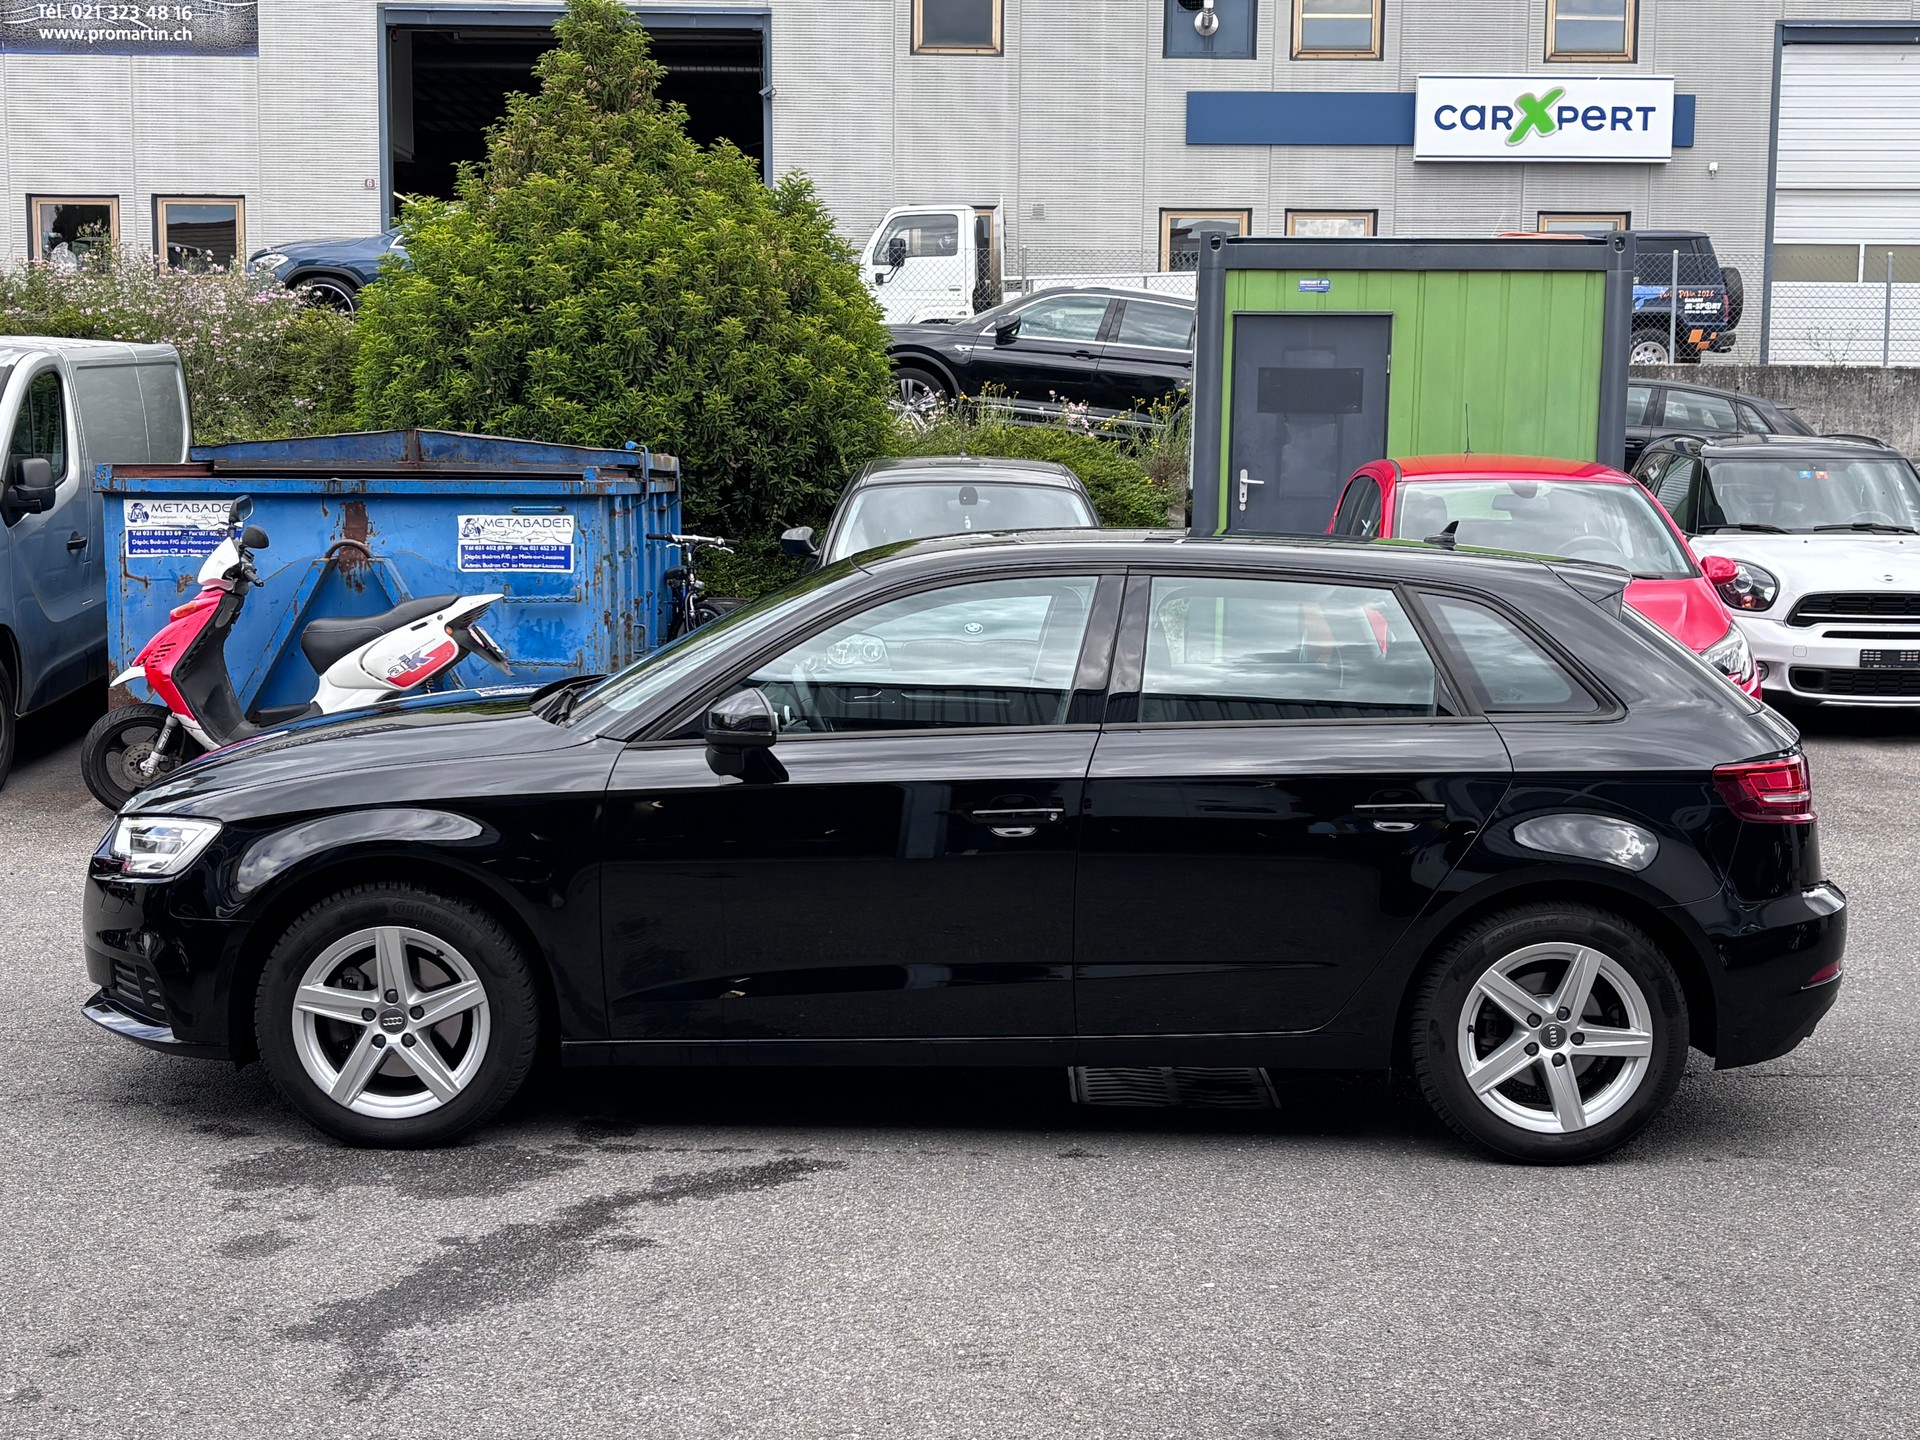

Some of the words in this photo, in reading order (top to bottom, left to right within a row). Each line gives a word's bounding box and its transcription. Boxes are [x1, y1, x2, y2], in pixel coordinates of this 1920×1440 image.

[38, 3, 66, 19] Tél.
[71, 4, 101, 20] 021
[109, 5, 140, 20] 323
[146, 5, 169, 20] 48
[175, 5, 193, 21] 16
[39, 27, 193, 43] www.promartin.ch
[150, 503, 232, 513] METABADE
[483, 518, 572, 528] METABADER
